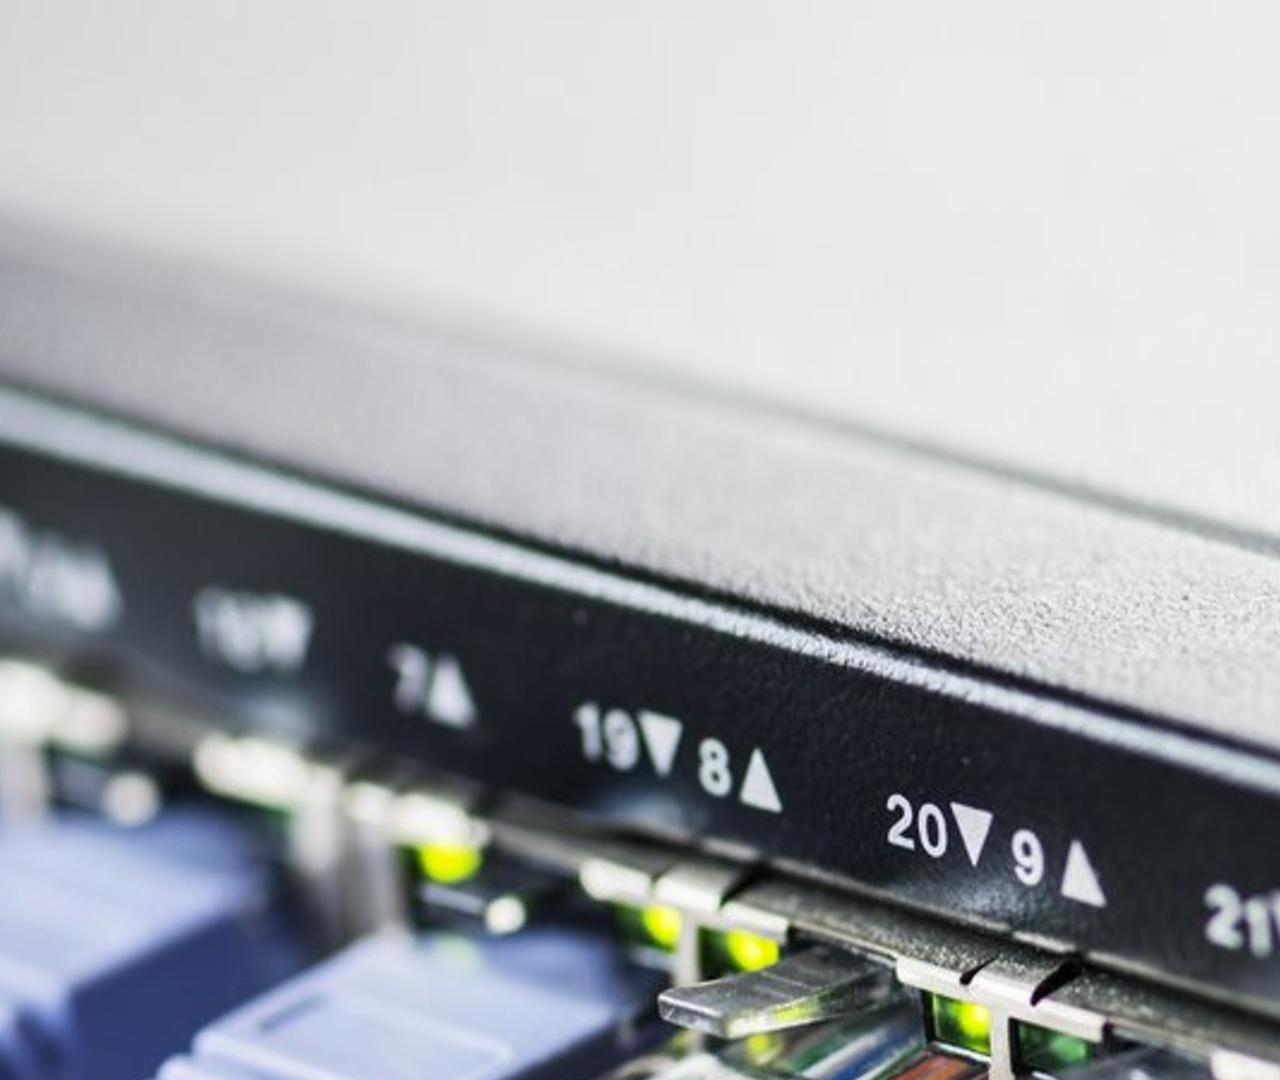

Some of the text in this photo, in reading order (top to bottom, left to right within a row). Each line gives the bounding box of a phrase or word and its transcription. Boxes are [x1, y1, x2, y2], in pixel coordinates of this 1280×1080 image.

[574, 702, 639, 771] 19
[699, 737, 733, 798] 8
[887, 793, 947, 858] 20
[1012, 829, 1045, 887] 9
[1204, 883, 1272, 960] 21
